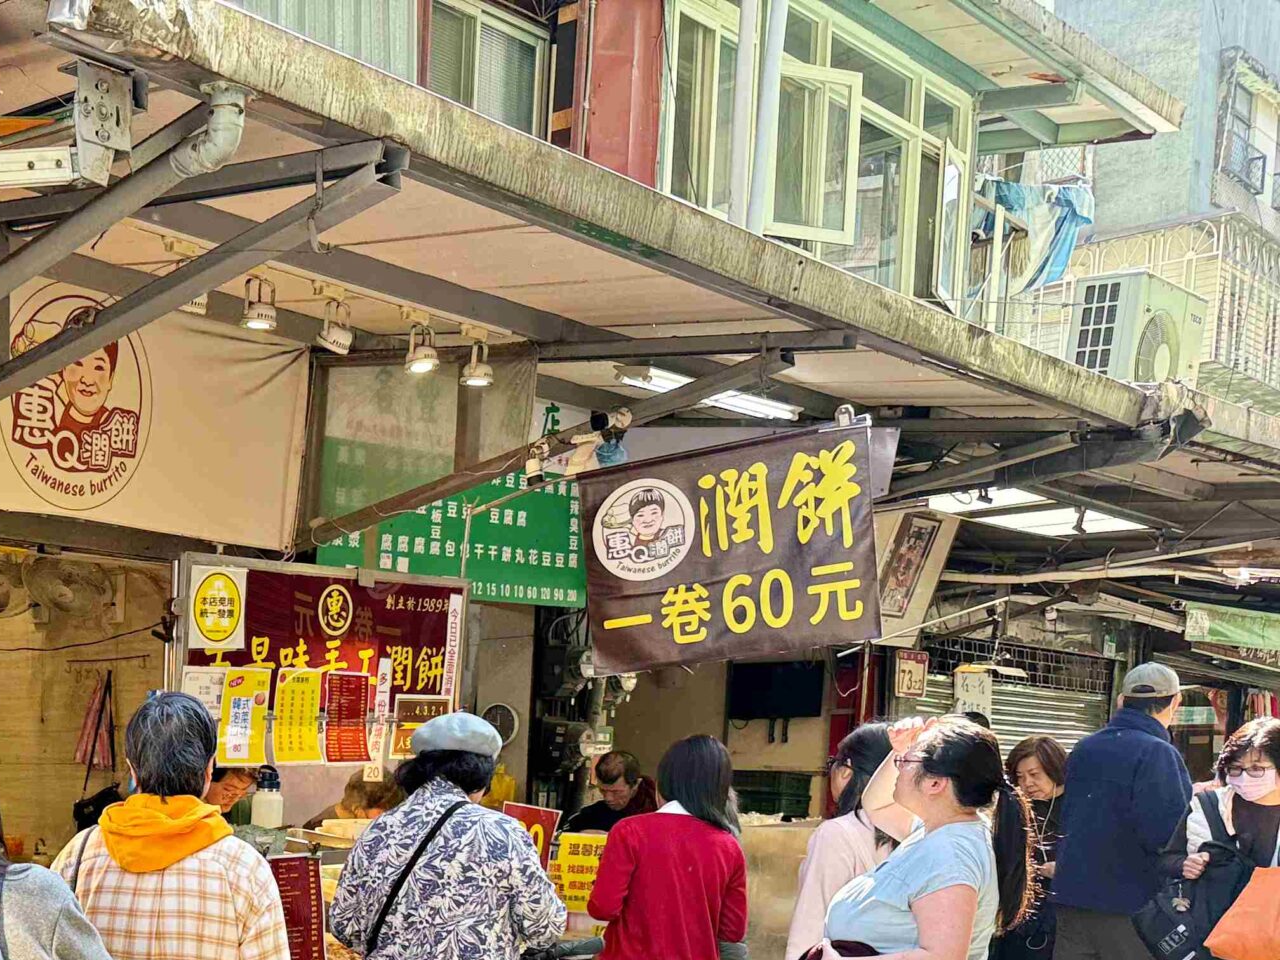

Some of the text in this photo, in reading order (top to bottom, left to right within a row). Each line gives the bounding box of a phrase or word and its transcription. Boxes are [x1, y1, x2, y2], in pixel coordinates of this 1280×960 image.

[13, 385, 137, 471] 惠Q潤餅
[25, 453, 127, 496] Taiwanese burrito
[697, 439, 862, 559] 潤餅
[606, 525, 686, 564] 惠Q潤餅
[616, 548, 681, 575] Taiwanese burrito
[199, 597, 236, 608] 本店免用
[367, 766, 380, 778] 20
